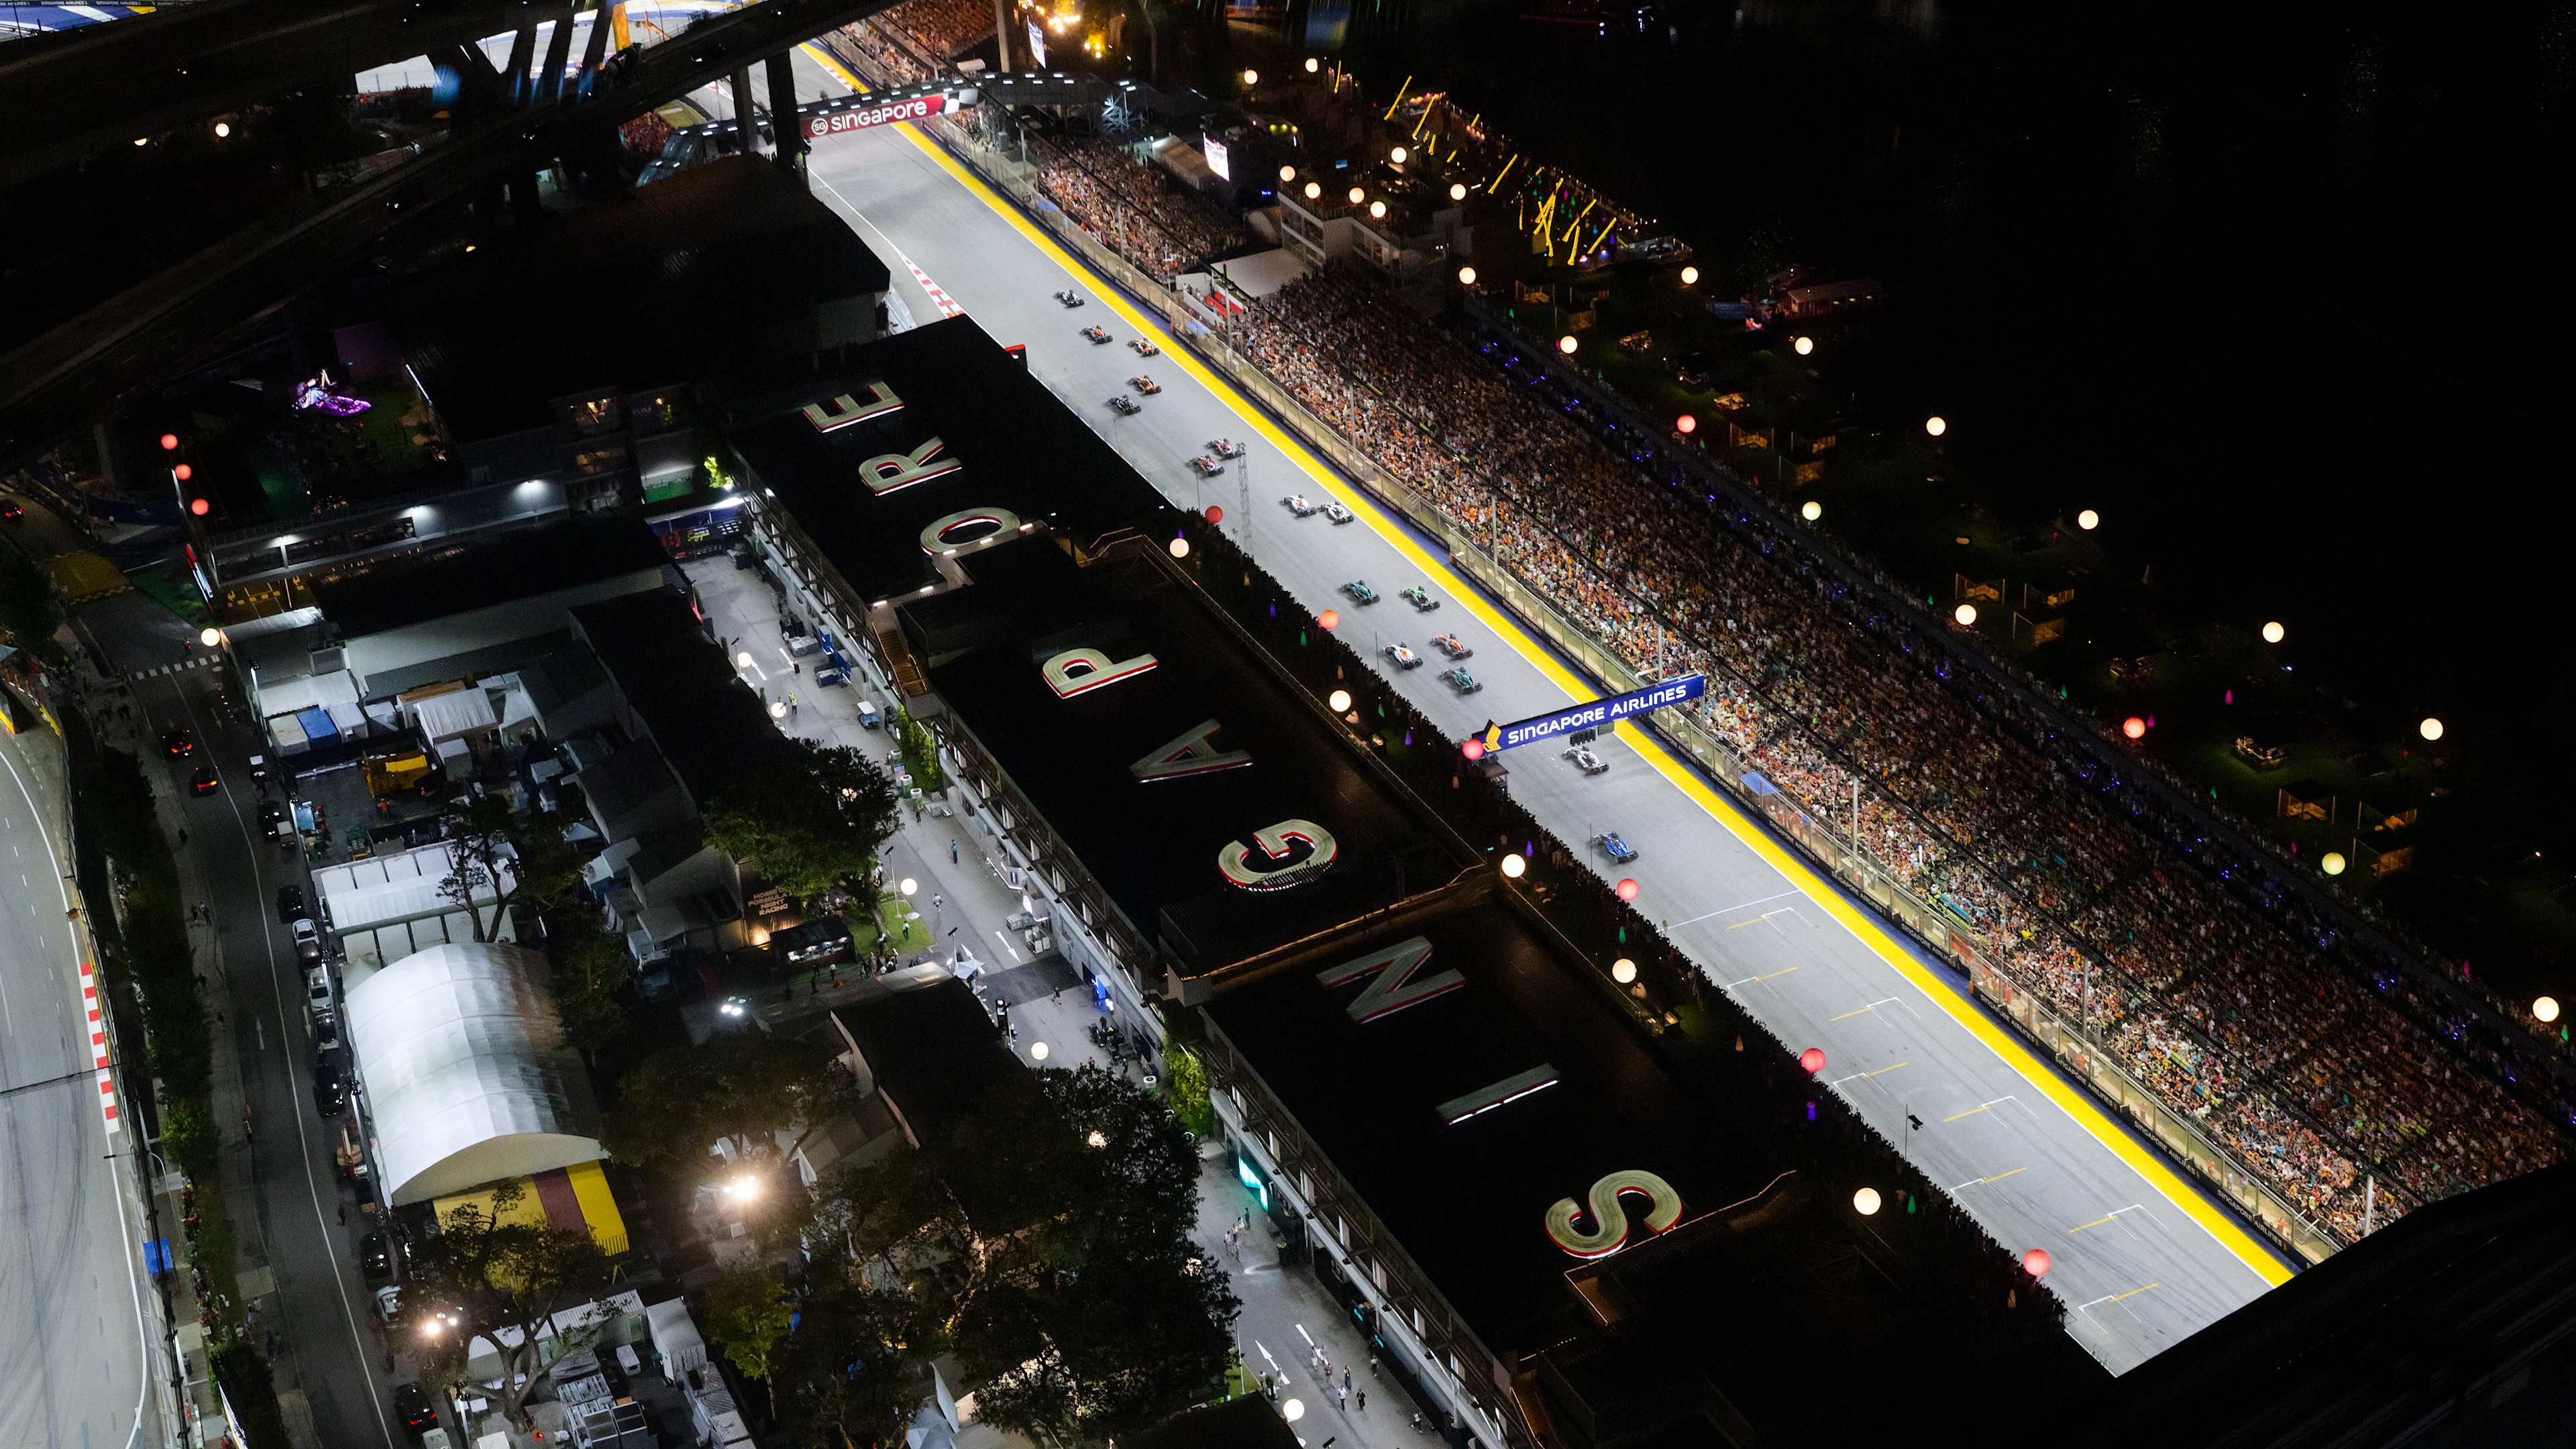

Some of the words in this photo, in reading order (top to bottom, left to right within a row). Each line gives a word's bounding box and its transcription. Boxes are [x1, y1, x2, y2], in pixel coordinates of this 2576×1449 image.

[1507, 706, 1606, 745] SINGAPORE
[1610, 684, 1687, 716] AIRLINES
[758, 903, 789, 916] RACING
[2254, 1220, 2283, 1247] AIRLINES
